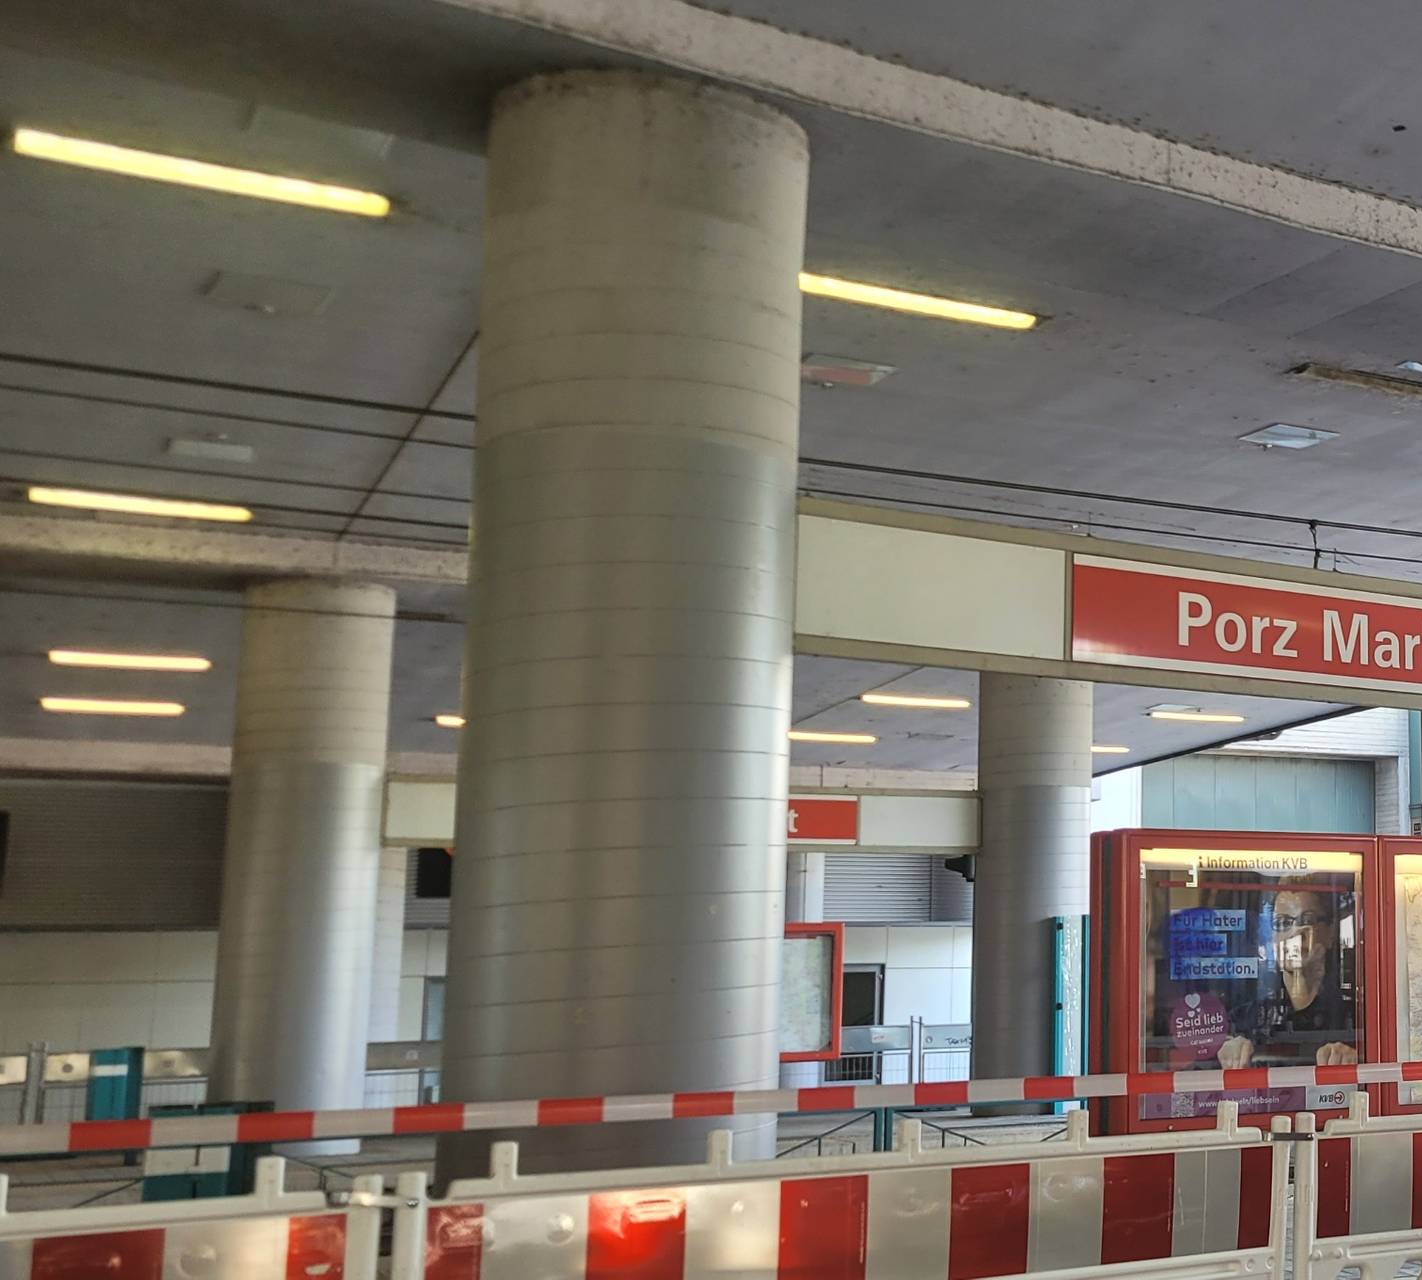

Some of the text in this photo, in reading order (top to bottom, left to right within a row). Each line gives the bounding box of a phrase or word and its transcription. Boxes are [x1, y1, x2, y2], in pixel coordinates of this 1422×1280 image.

[1176, 590, 1299, 658] Porz
[1206, 855, 1280, 870] Information
[1281, 857, 1309, 871] KVB
[1173, 912, 1243, 928] Für Hater
[1173, 961, 1256, 977] Endstation.
[1175, 1012, 1224, 1029] Seid lieb
[1176, 1025, 1225, 1038] zueinander
[1318, 1094, 1334, 1104] KVB
